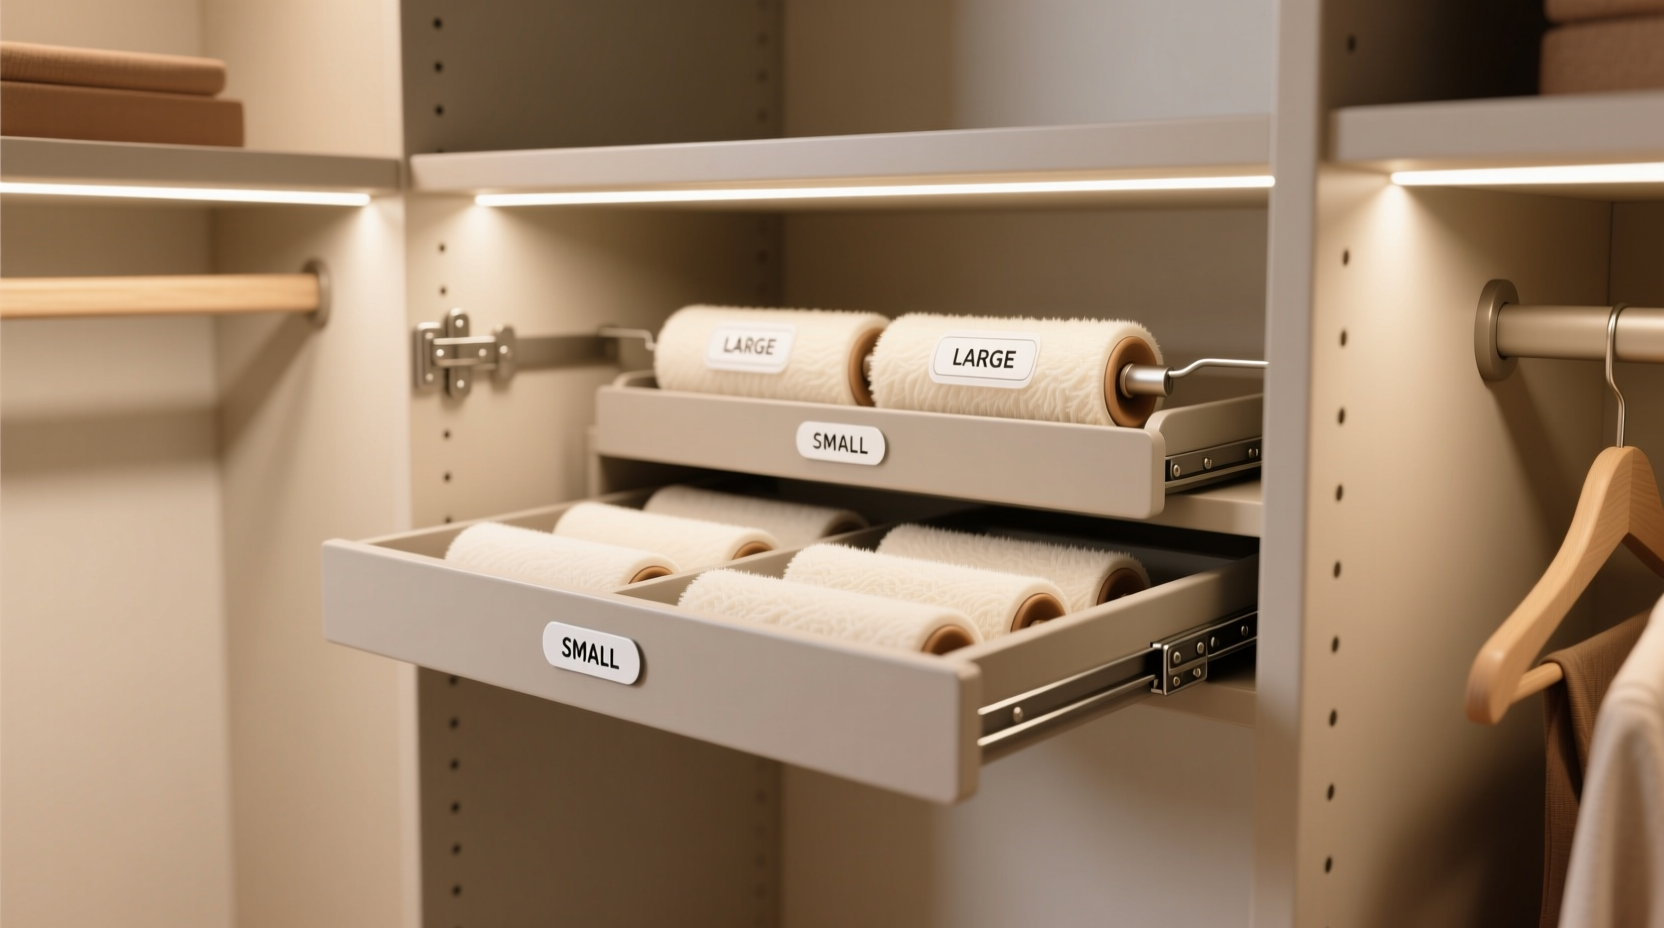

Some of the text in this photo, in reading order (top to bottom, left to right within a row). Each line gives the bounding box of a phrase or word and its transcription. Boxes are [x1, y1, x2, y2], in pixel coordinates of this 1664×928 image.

[723, 336, 776, 356] LARGE
[953, 348, 1016, 368] LARGE
[812, 432, 868, 455] SMALL
[561, 636, 620, 670] SMALL
